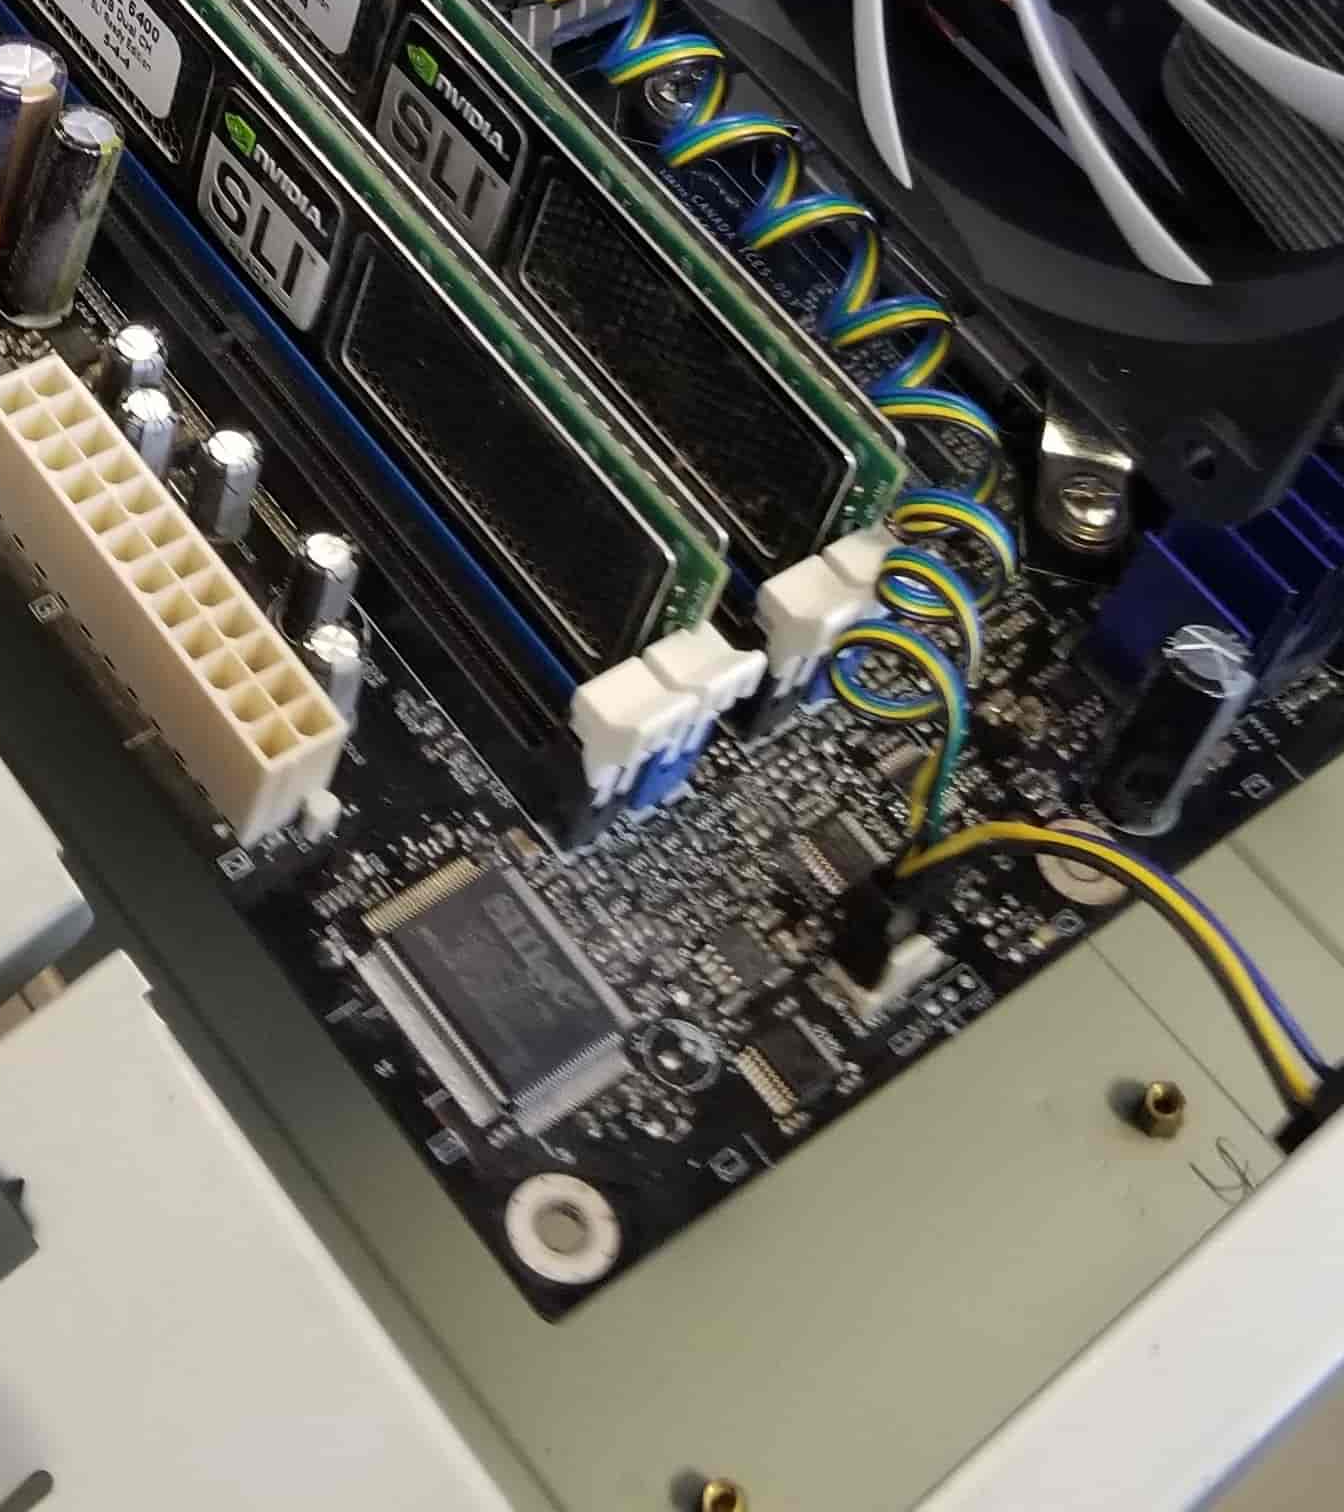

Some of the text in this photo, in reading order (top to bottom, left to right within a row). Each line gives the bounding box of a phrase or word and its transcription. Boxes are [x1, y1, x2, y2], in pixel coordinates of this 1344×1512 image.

[116, 8, 136, 38] Dual
[137, 32, 152, 55] CH
[392, 90, 485, 220] SLI
[435, 72, 505, 155] NVIDIA
[209, 161, 304, 297] SLI
[255, 143, 323, 232] NVIDIA
